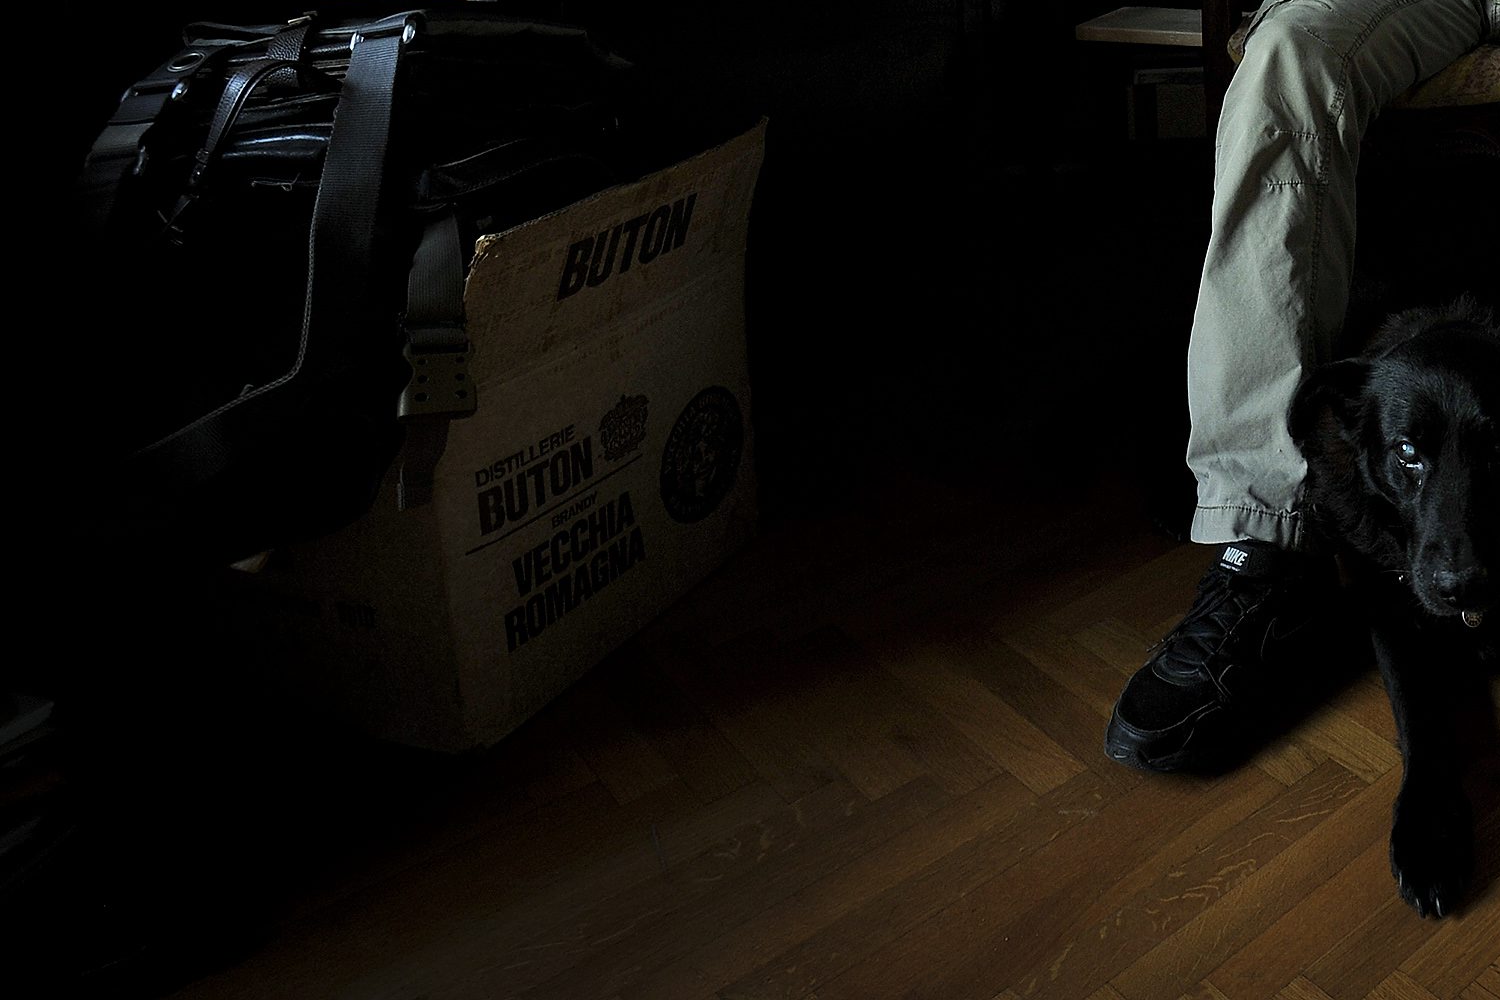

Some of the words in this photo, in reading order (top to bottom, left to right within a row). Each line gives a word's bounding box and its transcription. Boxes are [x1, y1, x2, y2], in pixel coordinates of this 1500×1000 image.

[556, 191, 698, 303] BUTON
[474, 424, 576, 488] DISTILLERIE
[477, 436, 594, 537] BUTON
[511, 491, 636, 597] VECCHIA
[550, 491, 598, 529] BRANDY
[1222, 546, 1249, 566] NIKE
[504, 527, 646, 653] ROMAGNA
